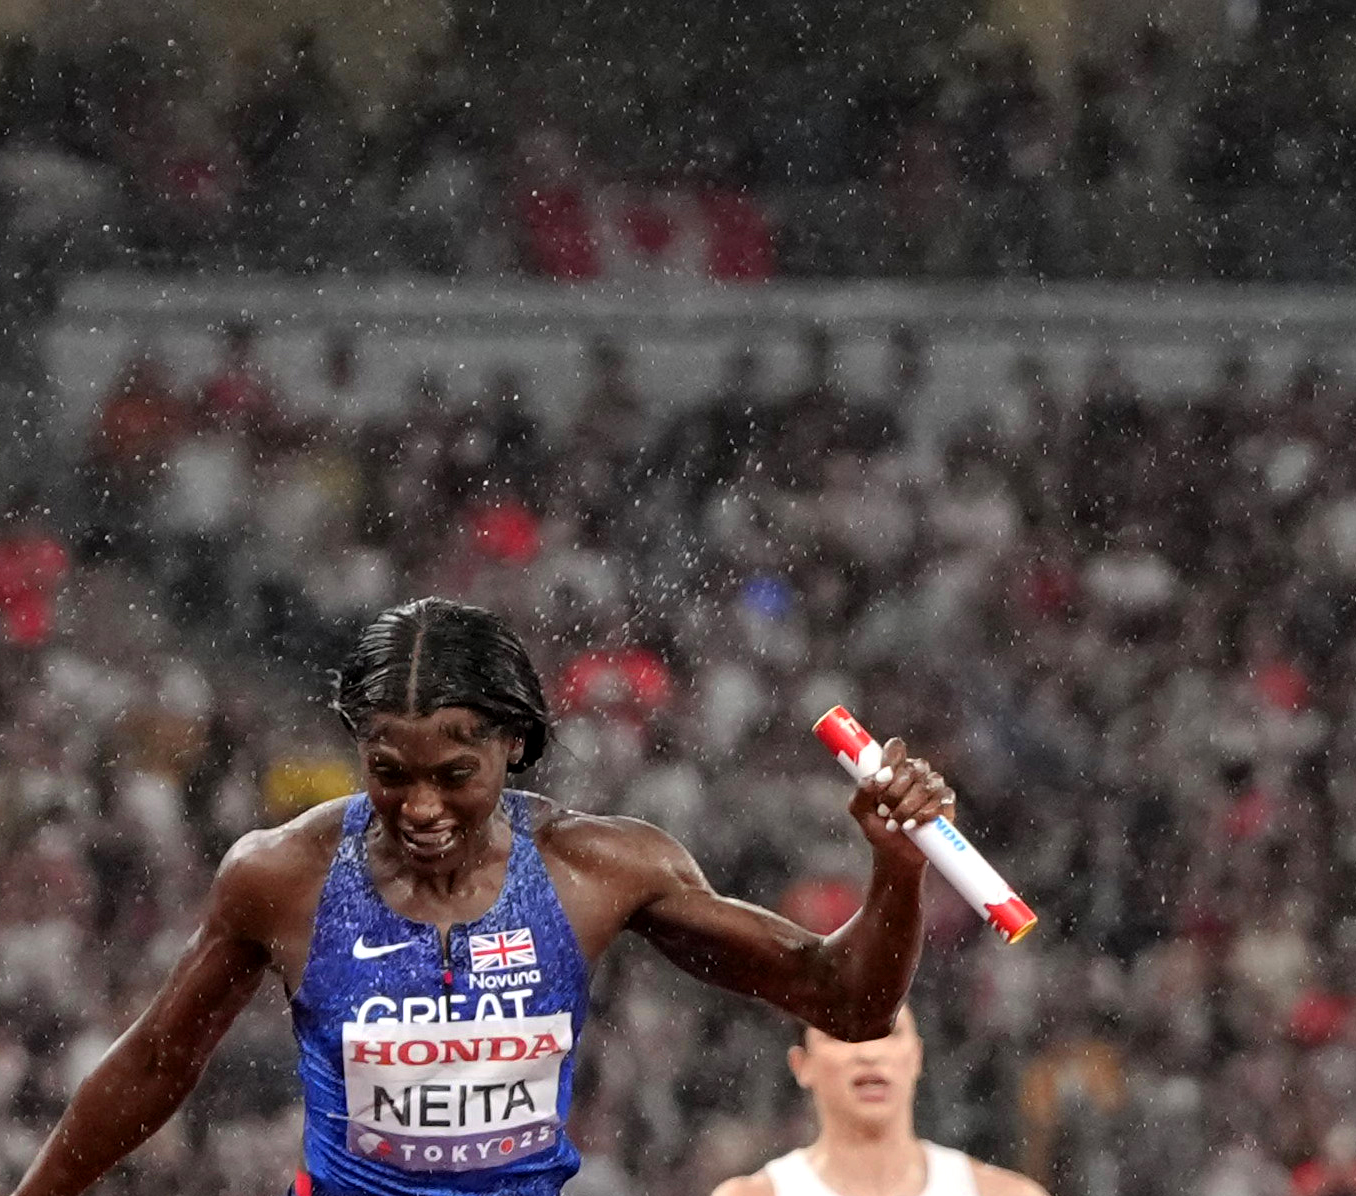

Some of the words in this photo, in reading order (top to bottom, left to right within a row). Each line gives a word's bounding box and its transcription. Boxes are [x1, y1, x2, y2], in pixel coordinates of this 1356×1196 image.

[469, 970, 541, 990] Novuna
[350, 1033, 563, 1066] HONDA
[373, 1079, 536, 1127] NEITA
